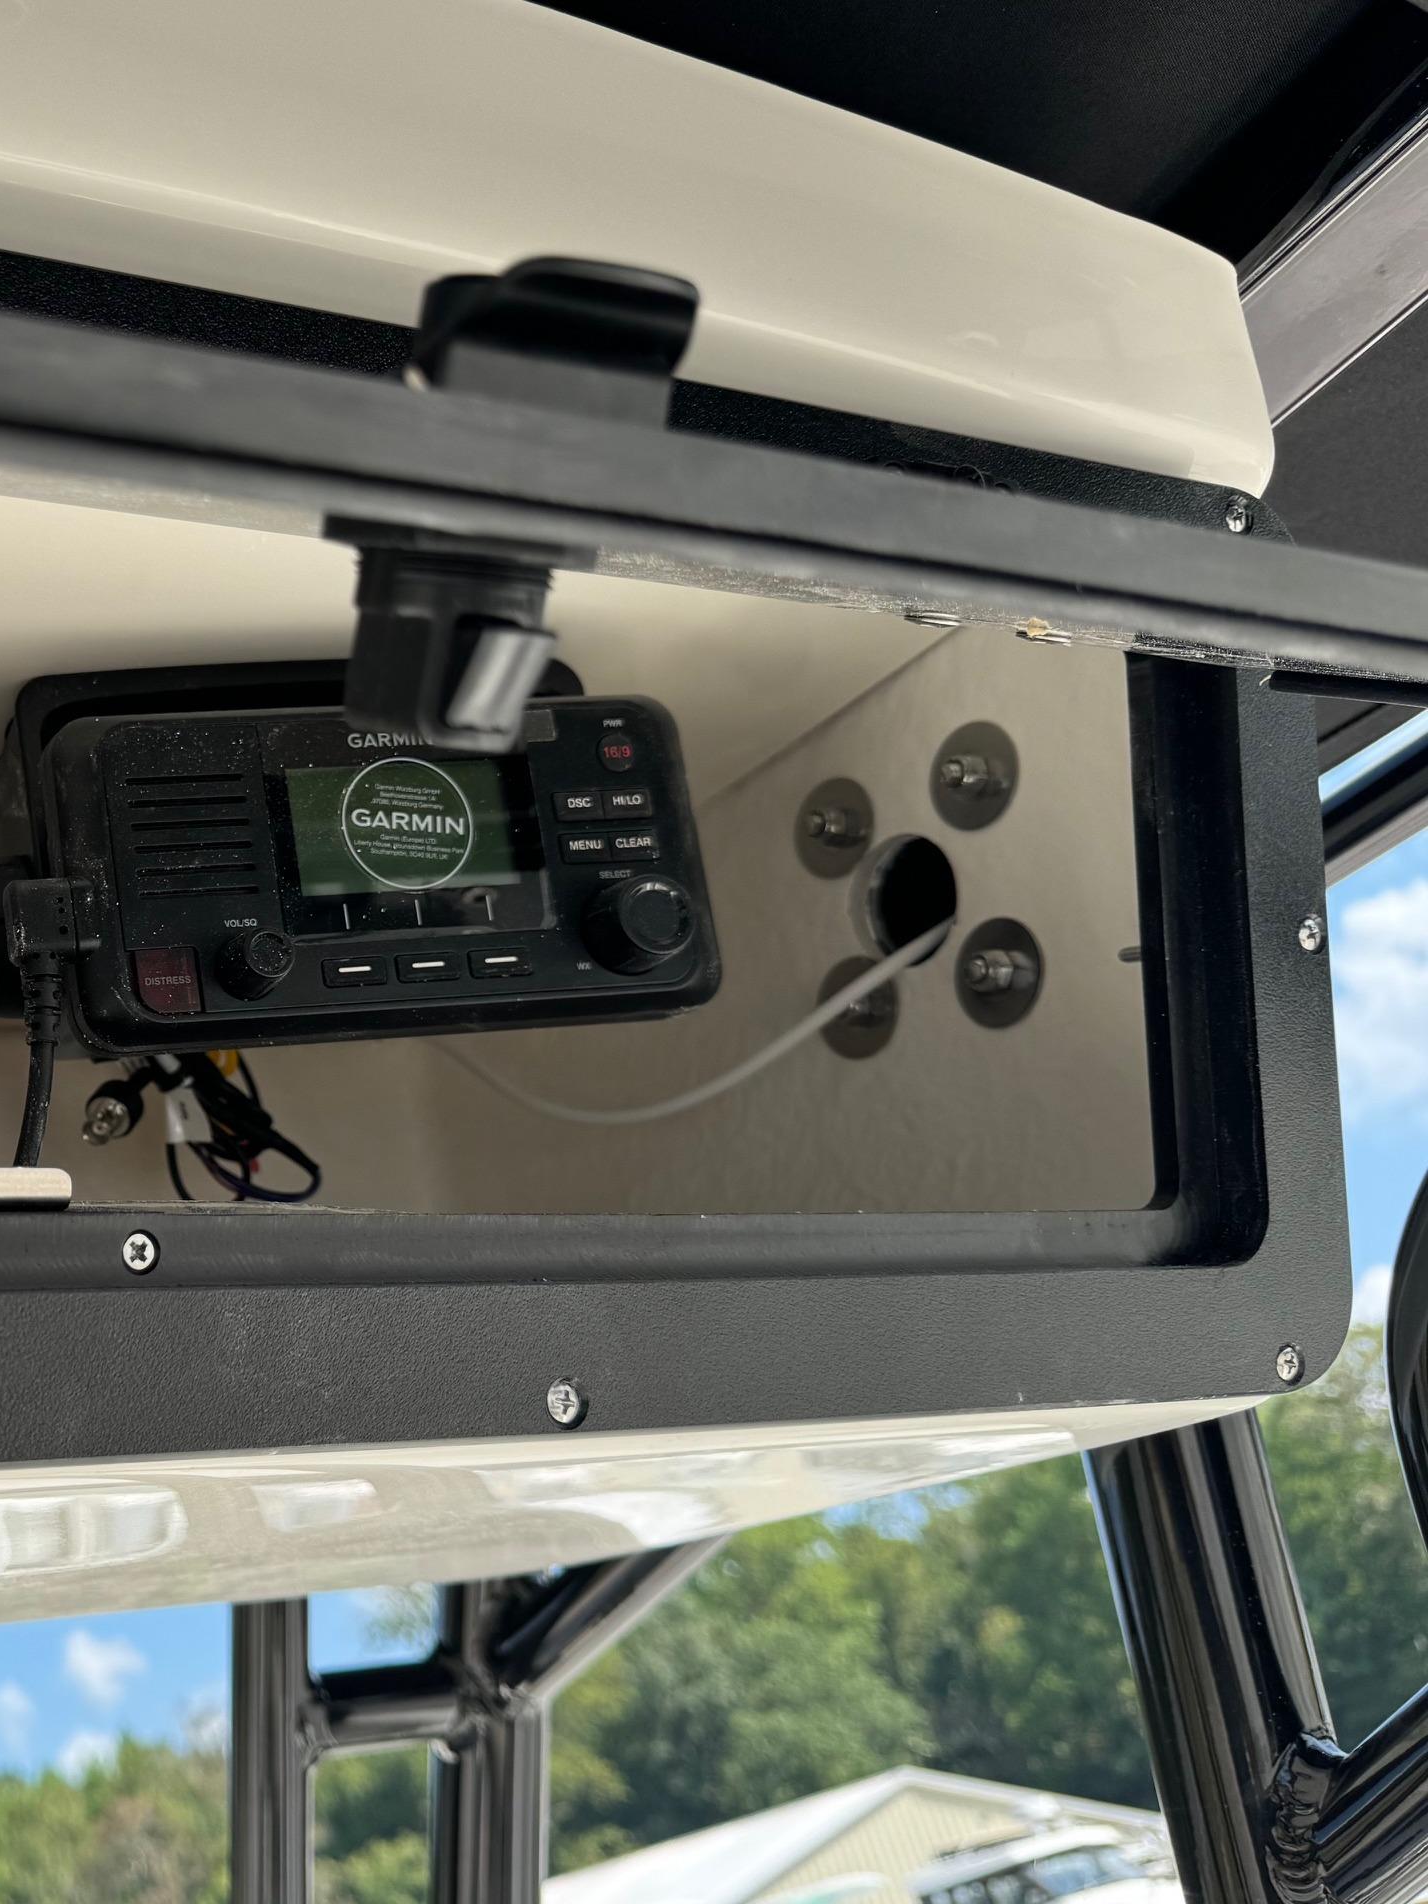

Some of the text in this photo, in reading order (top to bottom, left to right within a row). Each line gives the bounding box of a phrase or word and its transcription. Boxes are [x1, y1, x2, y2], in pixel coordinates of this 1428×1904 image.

[603, 719, 623, 727] PWR
[604, 746, 632, 758] 16/9
[567, 798, 592, 808] DSC
[612, 795, 642, 806] HI/LO
[351, 808, 465, 835] GARMIN
[569, 839, 602, 851] MENU
[615, 837, 652, 849] CLEAR
[599, 869, 632, 879] SELECT
[224, 918, 258, 928] VOL/SQ
[576, 962, 591, 970] WX
[144, 975, 192, 986] DISTRESS
